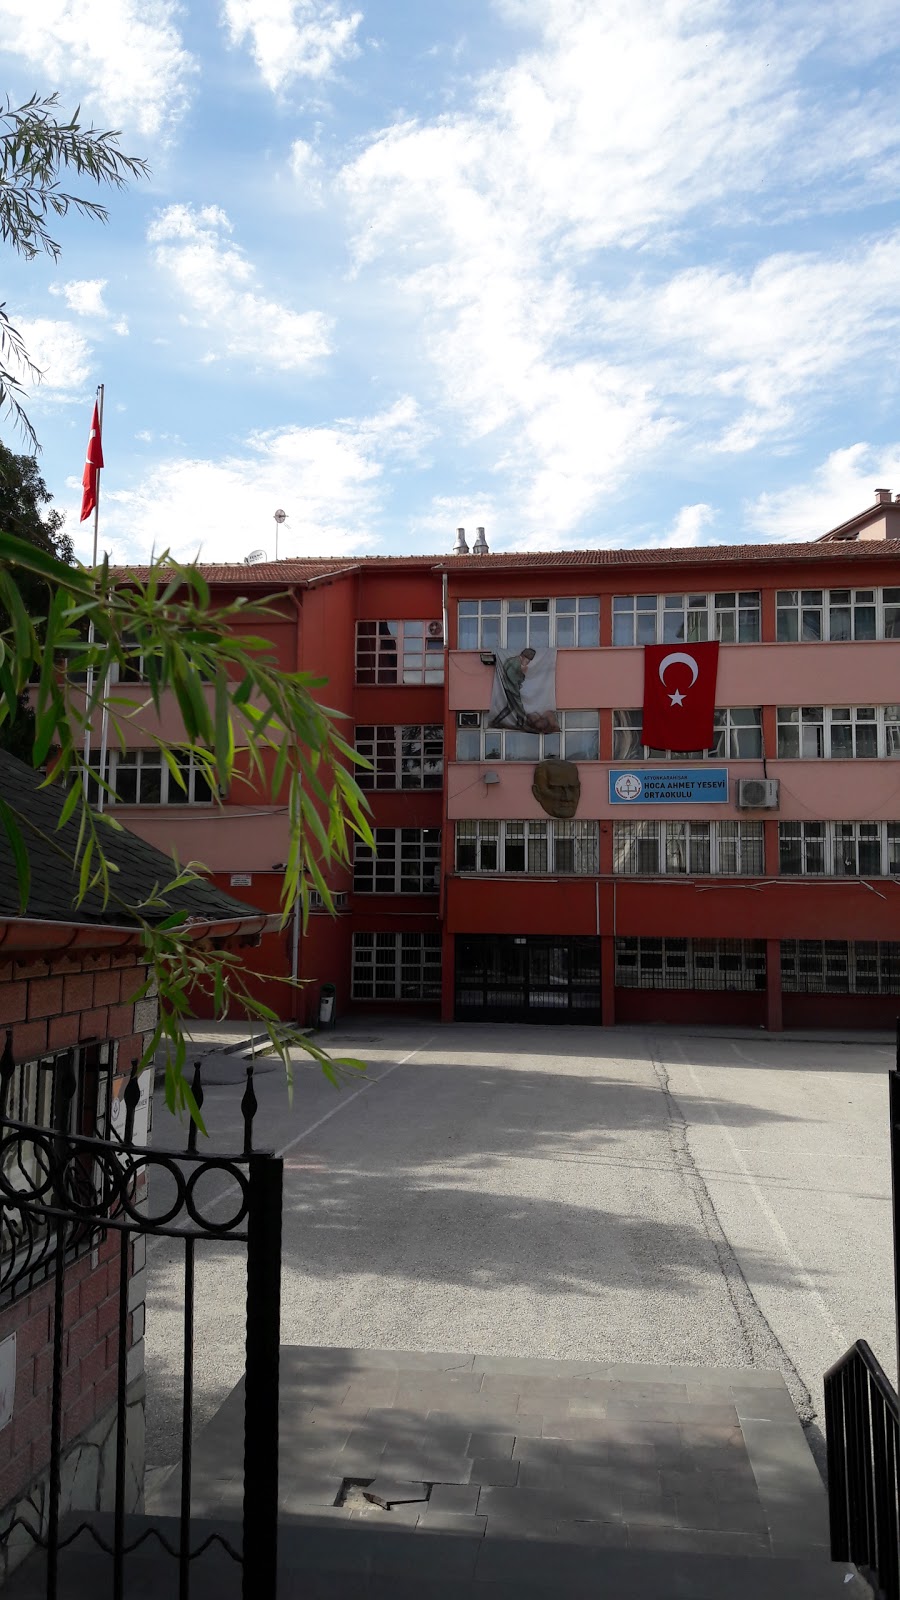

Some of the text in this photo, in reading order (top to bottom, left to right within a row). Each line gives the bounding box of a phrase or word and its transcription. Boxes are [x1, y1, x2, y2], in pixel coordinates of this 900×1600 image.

[667, 781, 695, 789] AHMET
[697, 779, 725, 788] YESEVİ
[644, 791, 692, 799] ORTAOKULU
